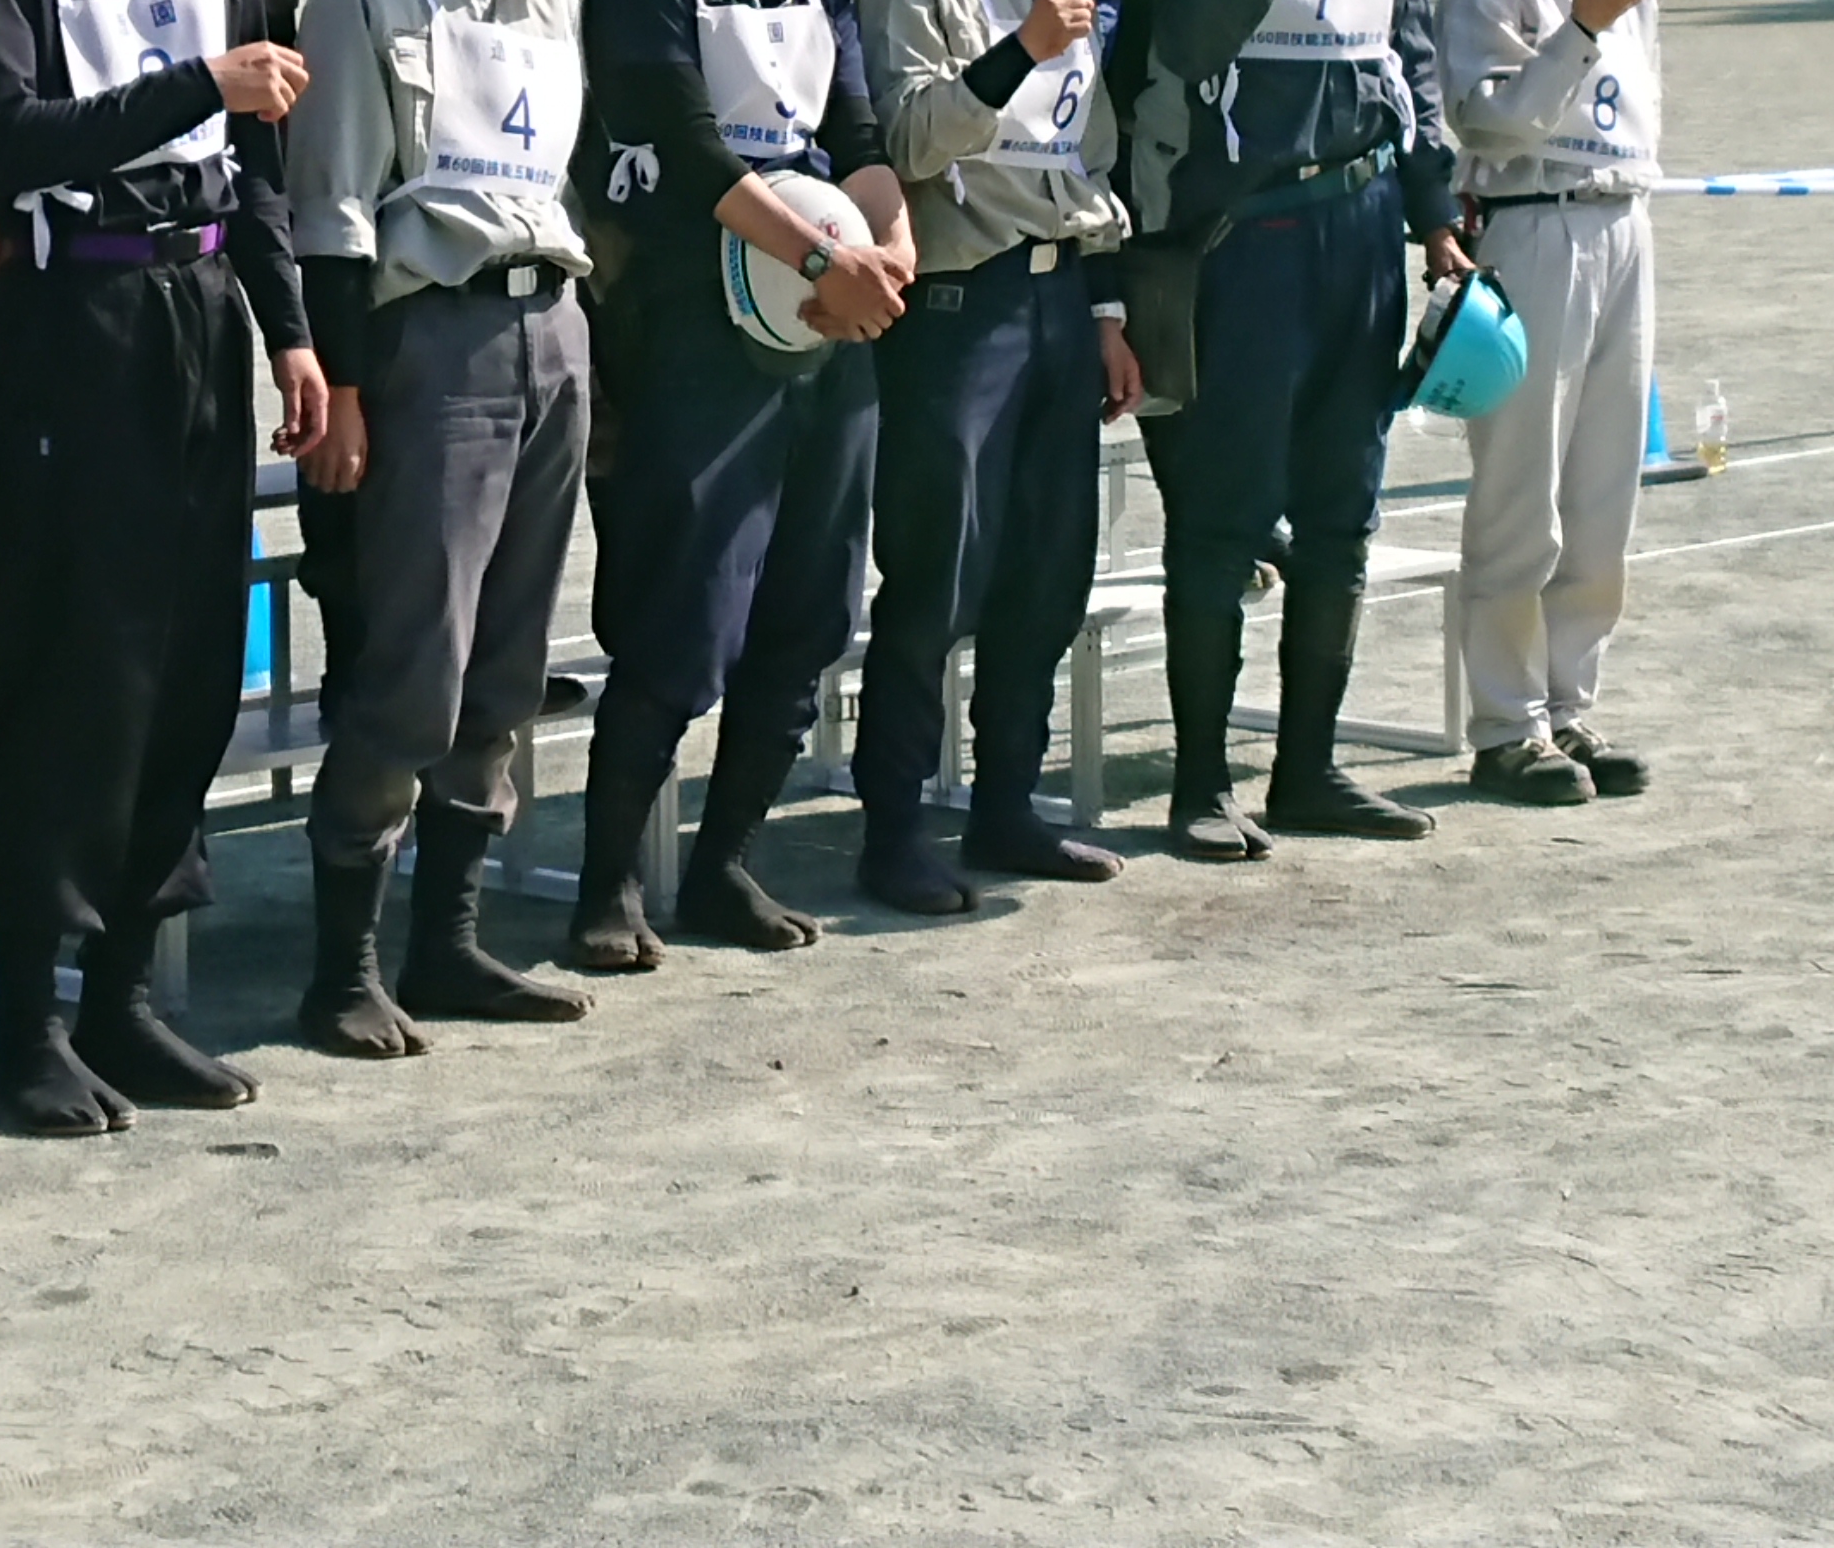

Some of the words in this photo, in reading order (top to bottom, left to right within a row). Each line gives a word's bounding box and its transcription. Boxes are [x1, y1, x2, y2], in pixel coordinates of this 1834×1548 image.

[500, 86, 537, 151] 4
[1051, 69, 1084, 130] 6
[1592, 74, 1620, 132] 8
